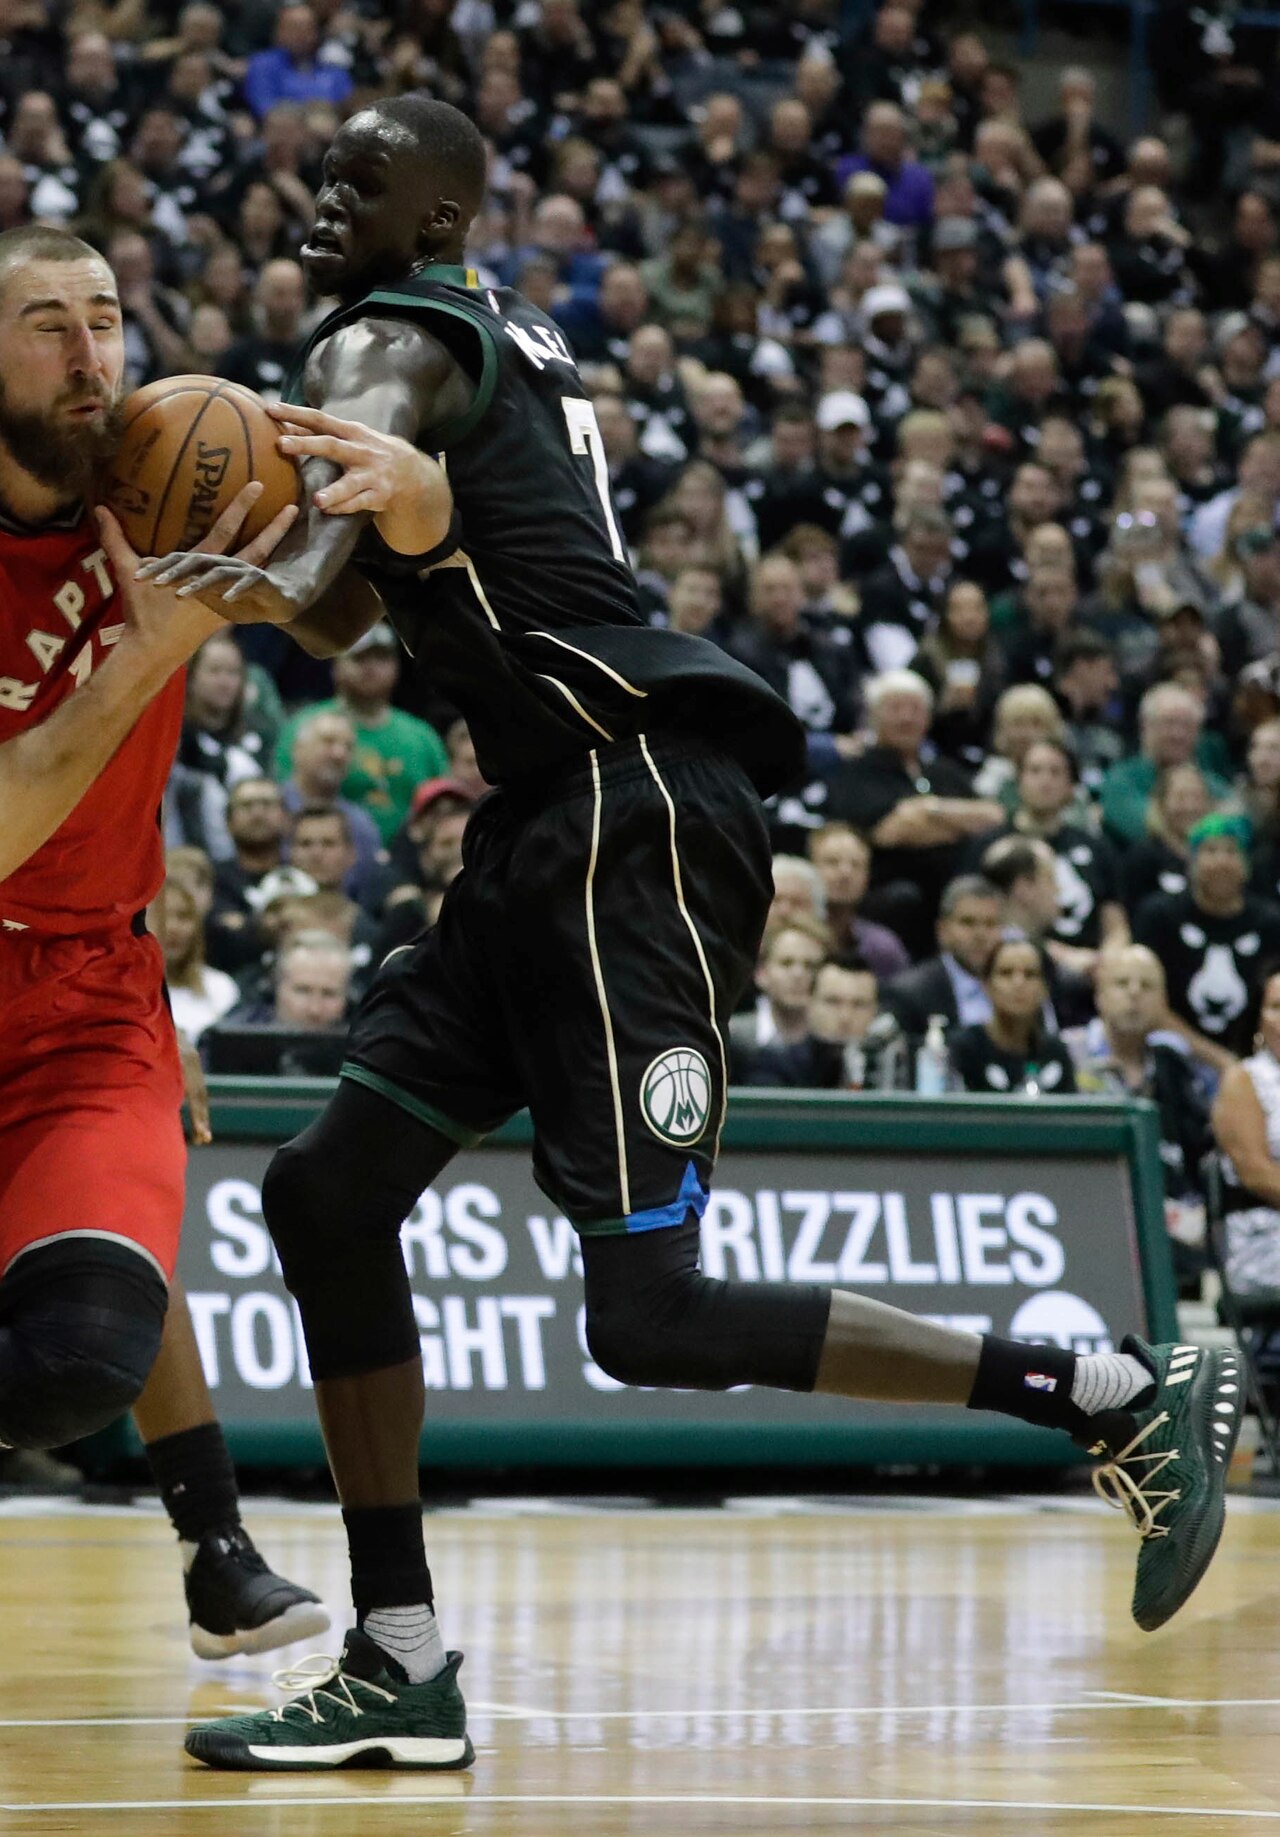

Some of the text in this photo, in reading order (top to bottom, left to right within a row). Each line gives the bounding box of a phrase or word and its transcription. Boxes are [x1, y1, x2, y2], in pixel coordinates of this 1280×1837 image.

[561, 396, 625, 563] 7
[206, 1178, 1066, 1288] SRS v RIZZLIES
[187, 1290, 557, 1391] TOHT
